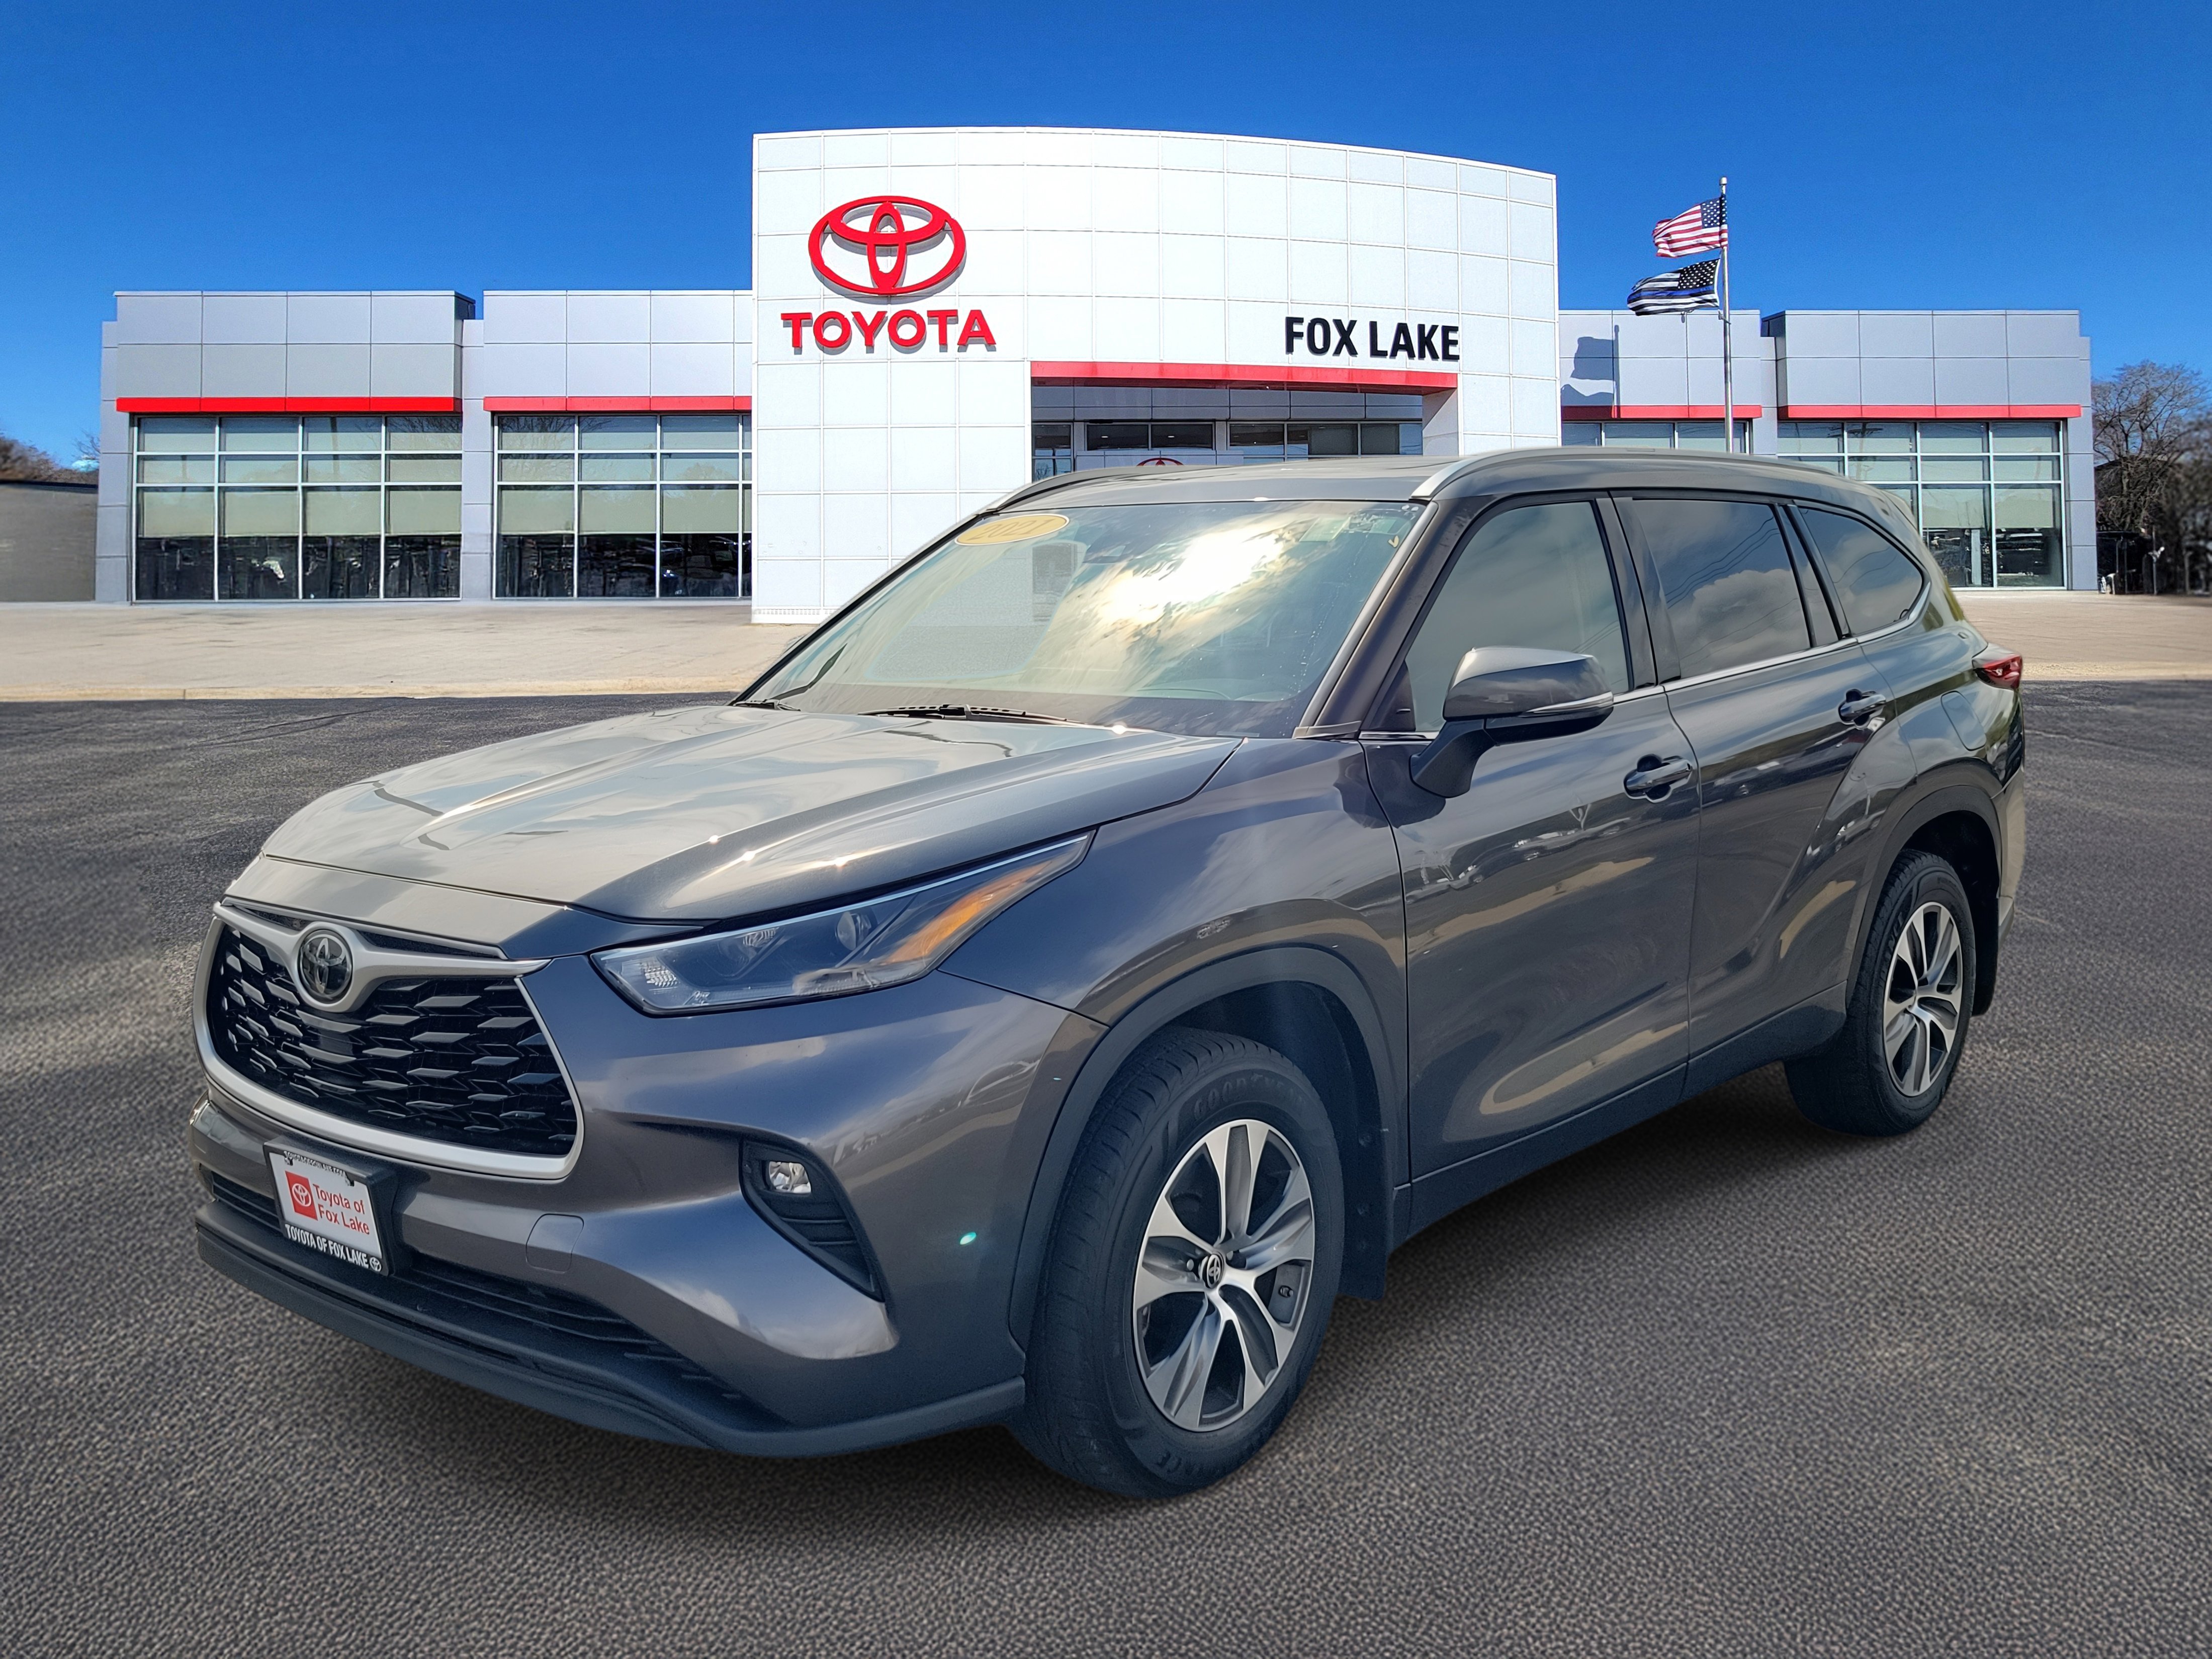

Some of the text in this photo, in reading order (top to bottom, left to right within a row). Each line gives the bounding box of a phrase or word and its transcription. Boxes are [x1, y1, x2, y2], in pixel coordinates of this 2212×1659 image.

[781, 309, 996, 349] TOYOTA
[1285, 316, 1460, 361] FOX LAKE
[966, 518, 1056, 541] 2021
[1194, 1073, 1306, 1120] GOODY
[313, 1184, 365, 1214] Toyota of
[318, 1204, 370, 1235] Fox Lake
[285, 1224, 369, 1268] TOYOTA OF FOX LAKE
